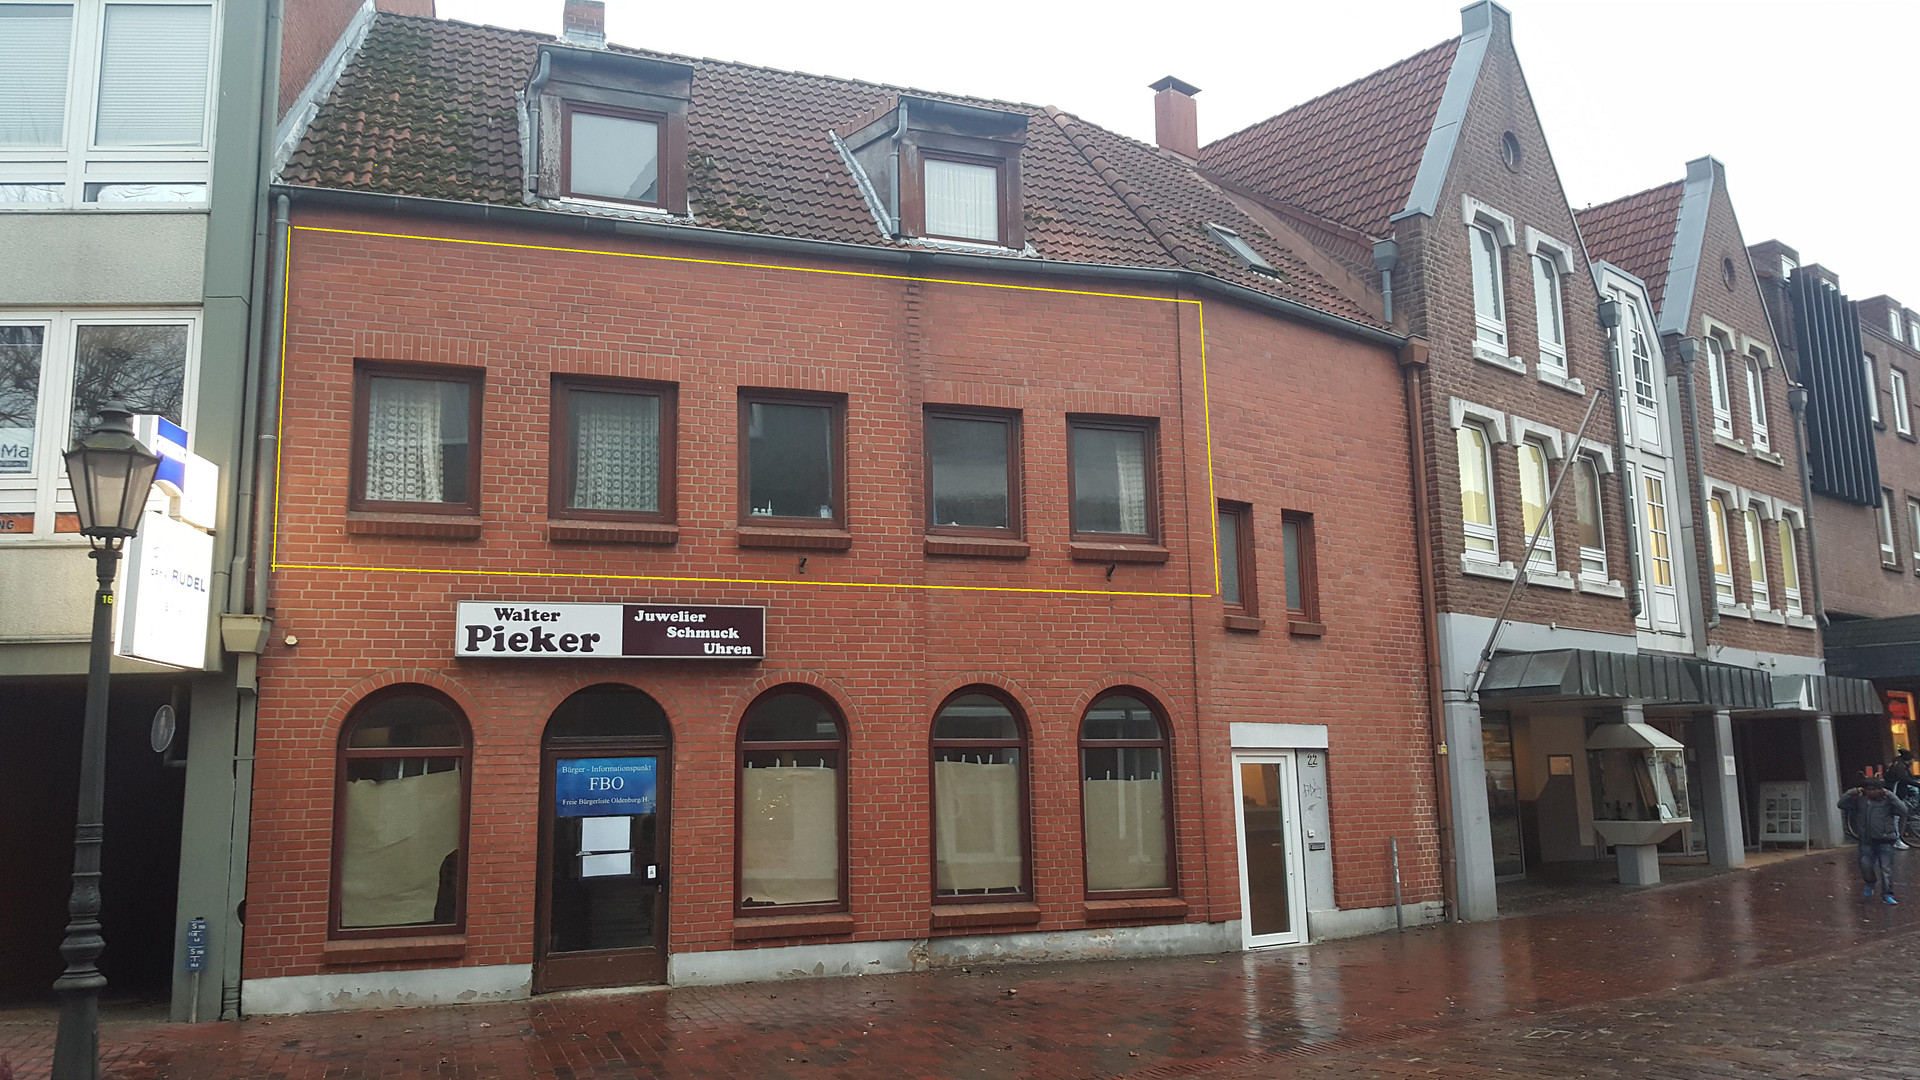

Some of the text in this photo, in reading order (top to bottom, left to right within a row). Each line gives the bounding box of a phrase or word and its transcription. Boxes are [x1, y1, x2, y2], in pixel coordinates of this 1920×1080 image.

[172, 568, 206, 593] RUDEL
[494, 607, 561, 622] Walter
[634, 609, 707, 623] Juwelier
[464, 624, 601, 652] Pieker
[666, 626, 740, 639] Schmuck
[703, 642, 752, 655] Uhren
[1307, 753, 1318, 766] 22
[562, 766, 585, 775] Bürger
[591, 764, 652, 773] Informationspunkt
[589, 776, 624, 791] FBO
[562, 798, 578, 806] Freie
[578, 798, 610, 806] Bürgerliste
